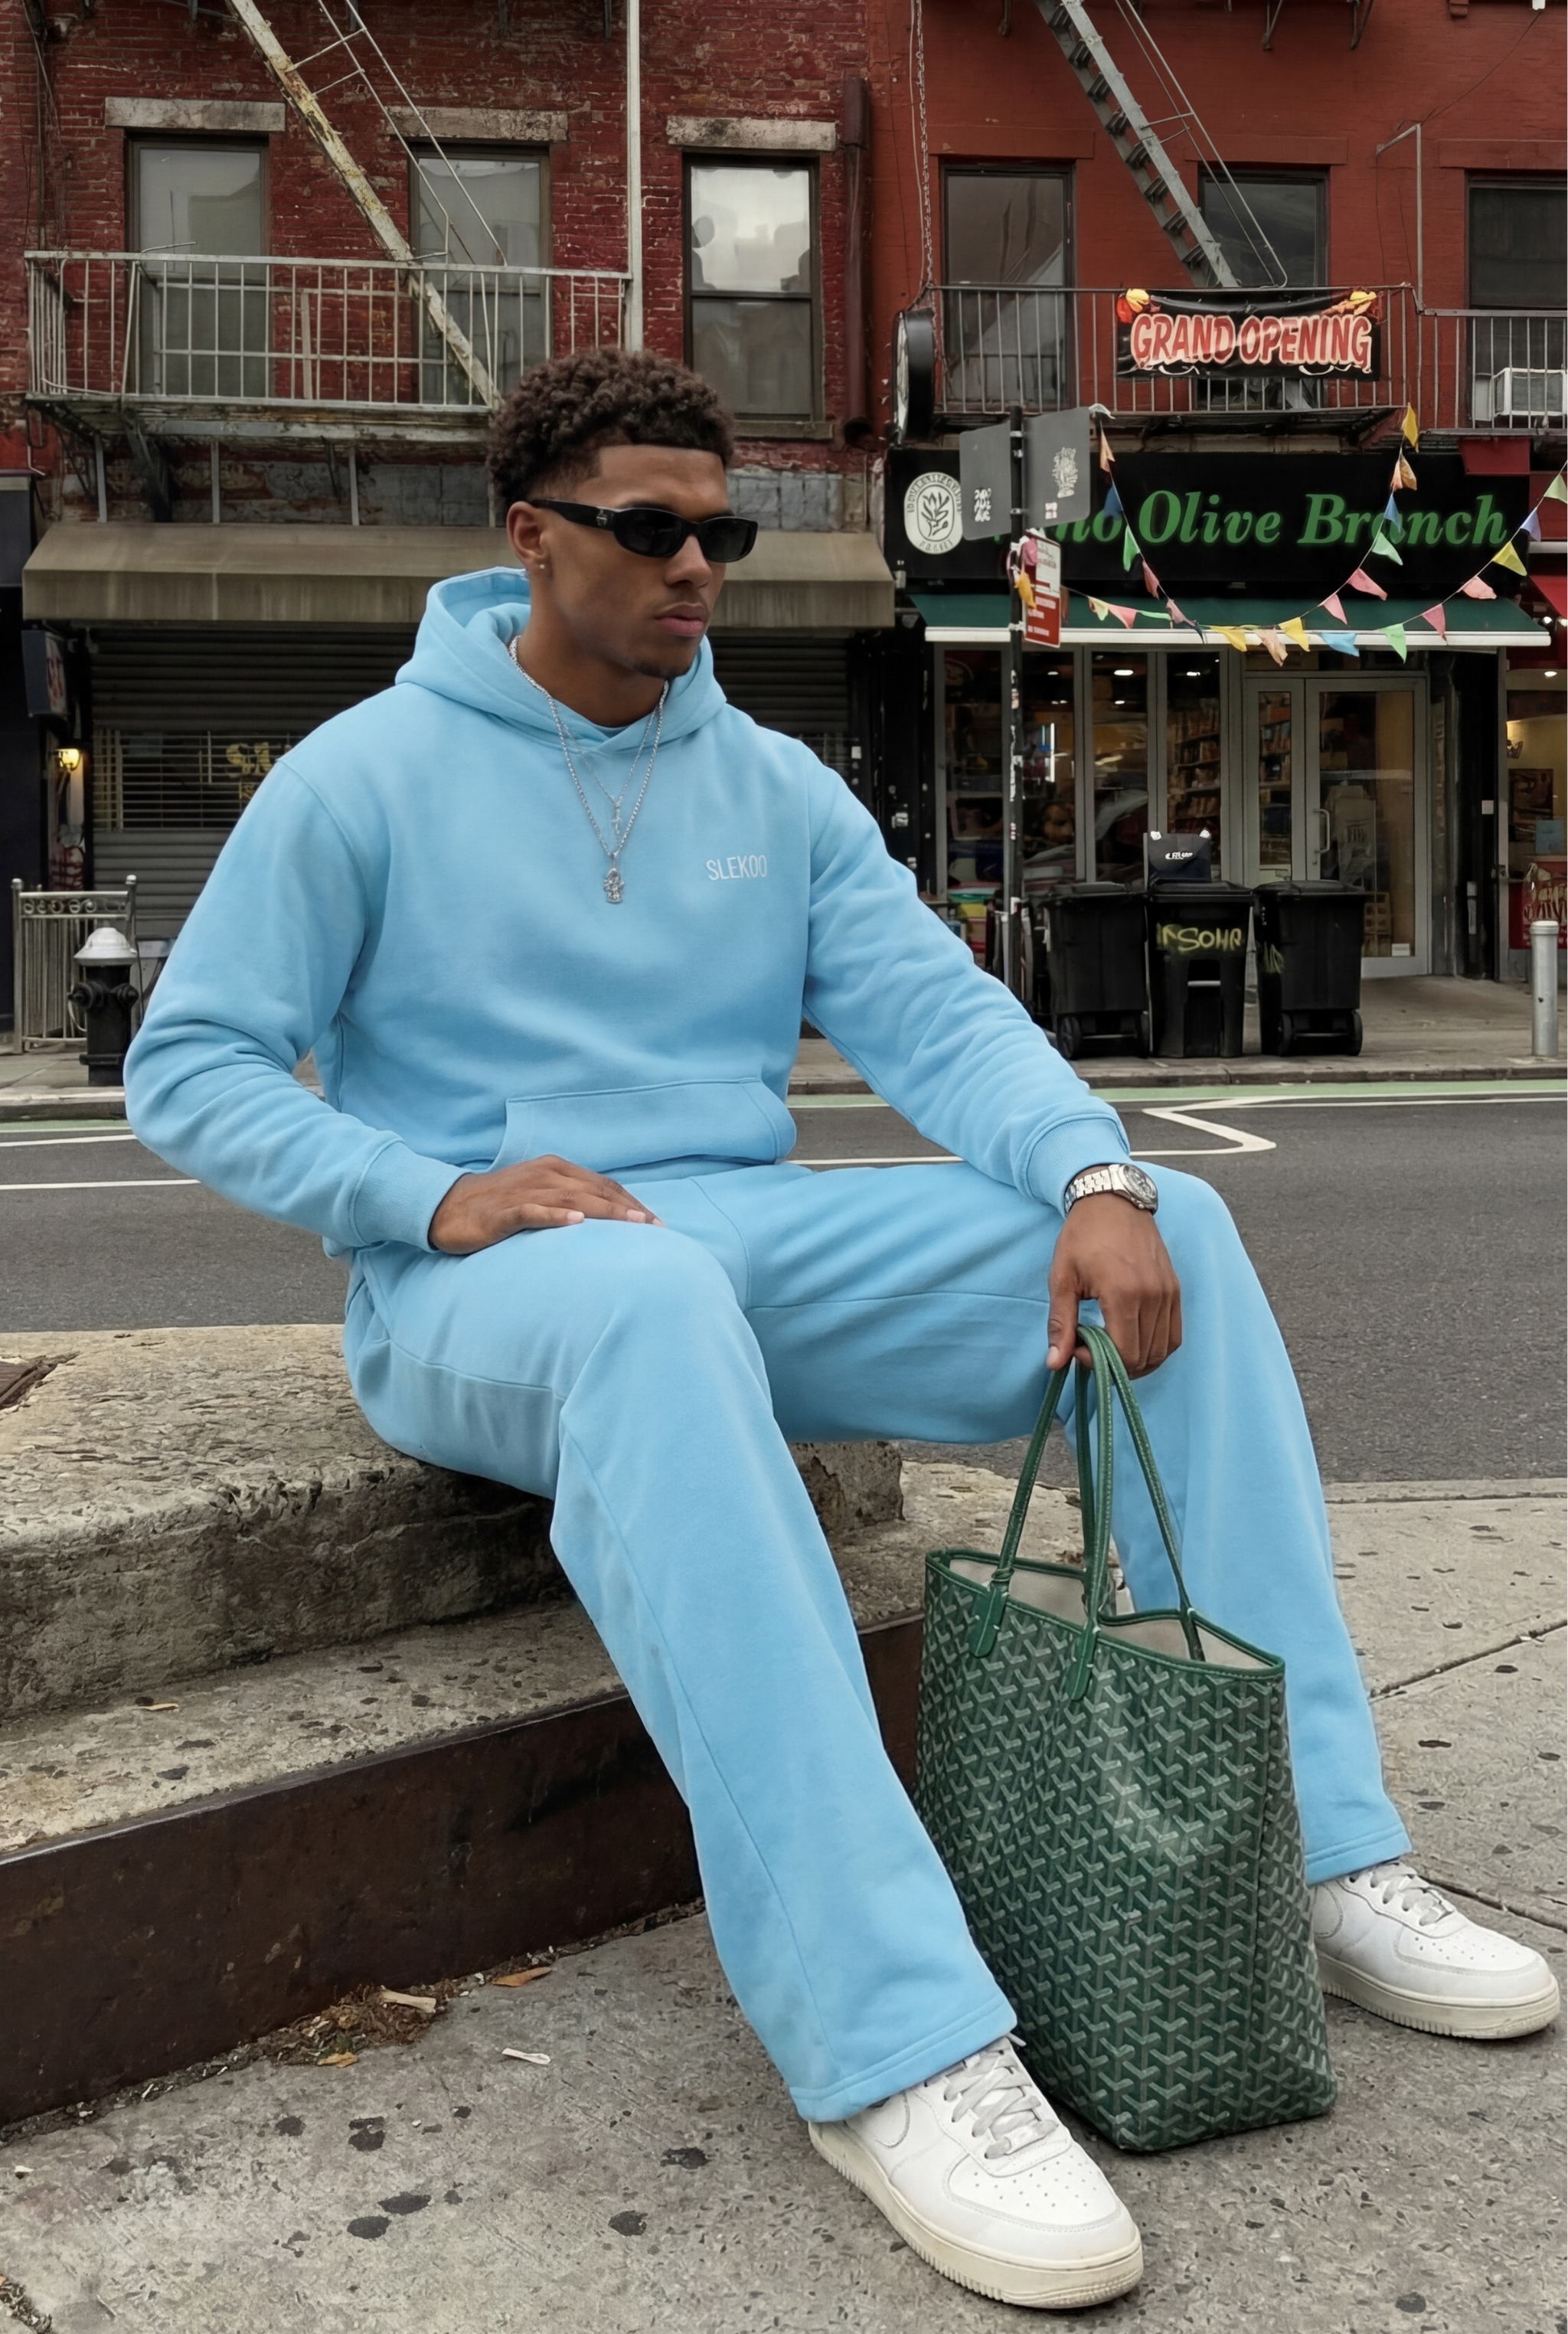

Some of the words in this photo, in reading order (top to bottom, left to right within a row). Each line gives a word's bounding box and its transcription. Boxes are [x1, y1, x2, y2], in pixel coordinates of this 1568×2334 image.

[1131, 313, 1236, 369] GRAND
[1239, 314, 1373, 374] OPENING
[1138, 489, 1282, 544] Olive
[706, 855, 767, 881] SLEKOO
